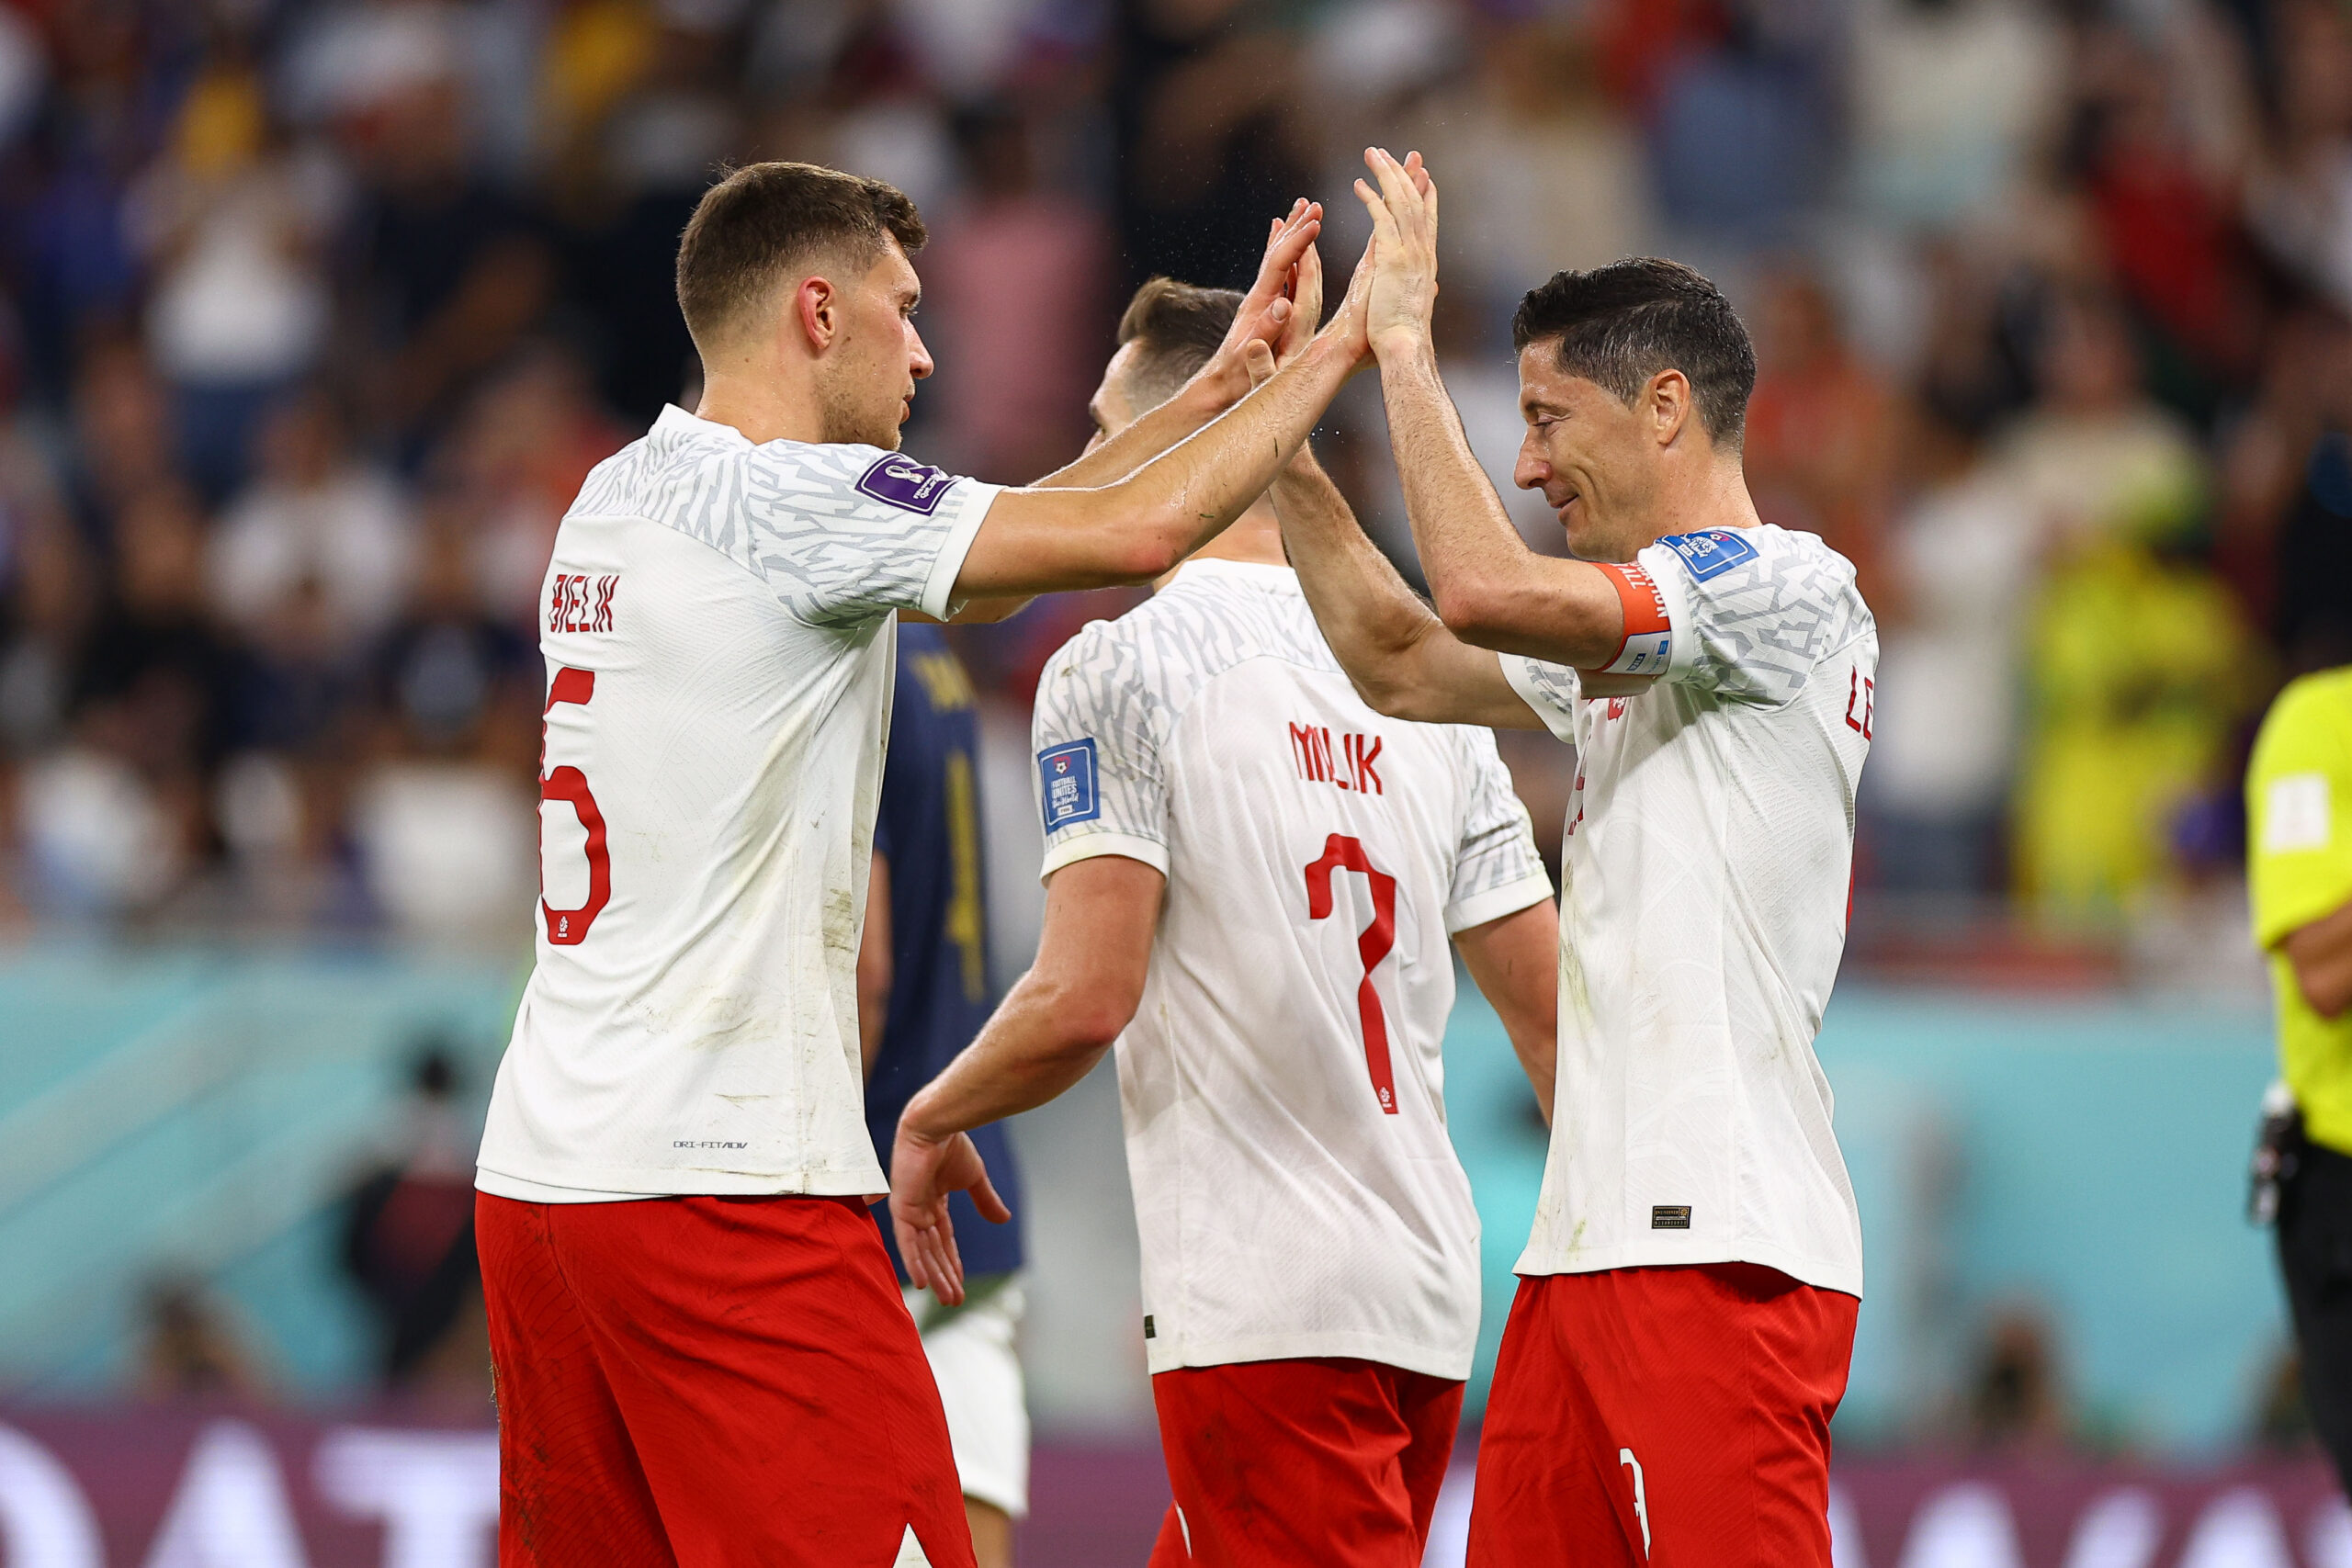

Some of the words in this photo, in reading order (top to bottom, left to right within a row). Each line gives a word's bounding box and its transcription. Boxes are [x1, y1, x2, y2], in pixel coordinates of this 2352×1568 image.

[549, 574, 620, 633] BIELIK
[537, 667, 611, 945] 6
[1289, 721, 1382, 795] MILIK
[1305, 832, 1399, 1115] 7
